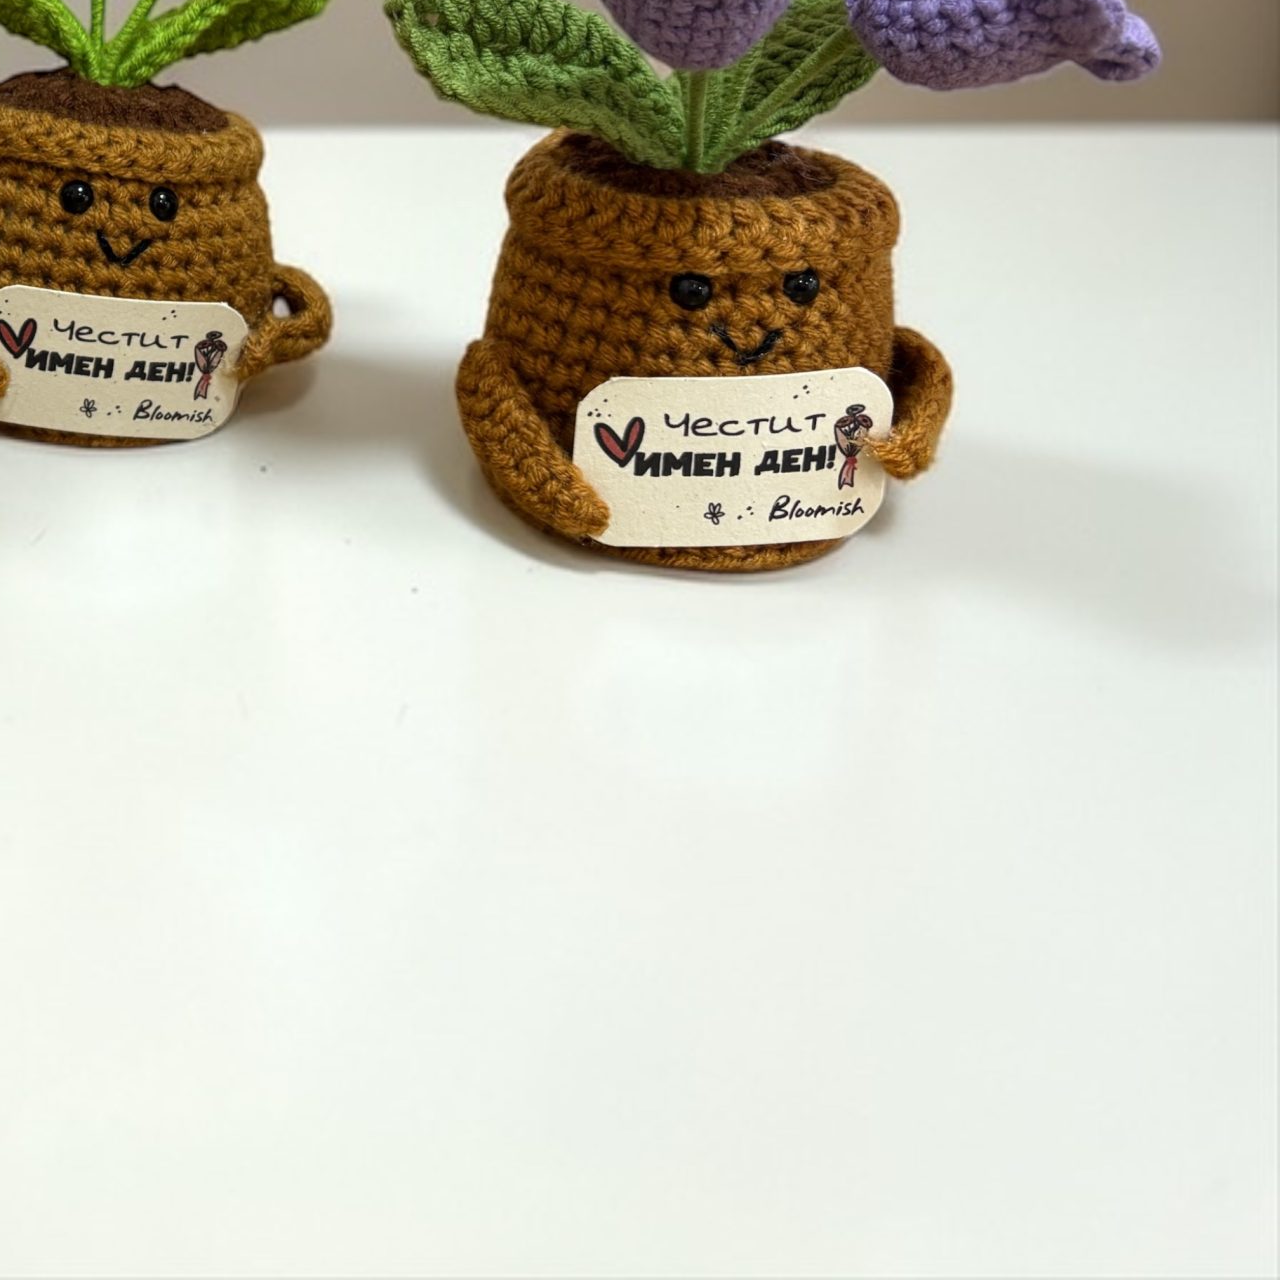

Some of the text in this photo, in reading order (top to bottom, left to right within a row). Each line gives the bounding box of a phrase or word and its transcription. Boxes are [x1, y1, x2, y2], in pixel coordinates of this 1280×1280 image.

[53, 318, 189, 349] Честит
[24, 348, 195, 382] ИМЕН ДЕН!
[133, 399, 213, 422] Bloomish
[664, 413, 826, 437] Честит
[633, 444, 837, 477] ИМЕН ДЕН!
[769, 495, 865, 521] Bloomish
